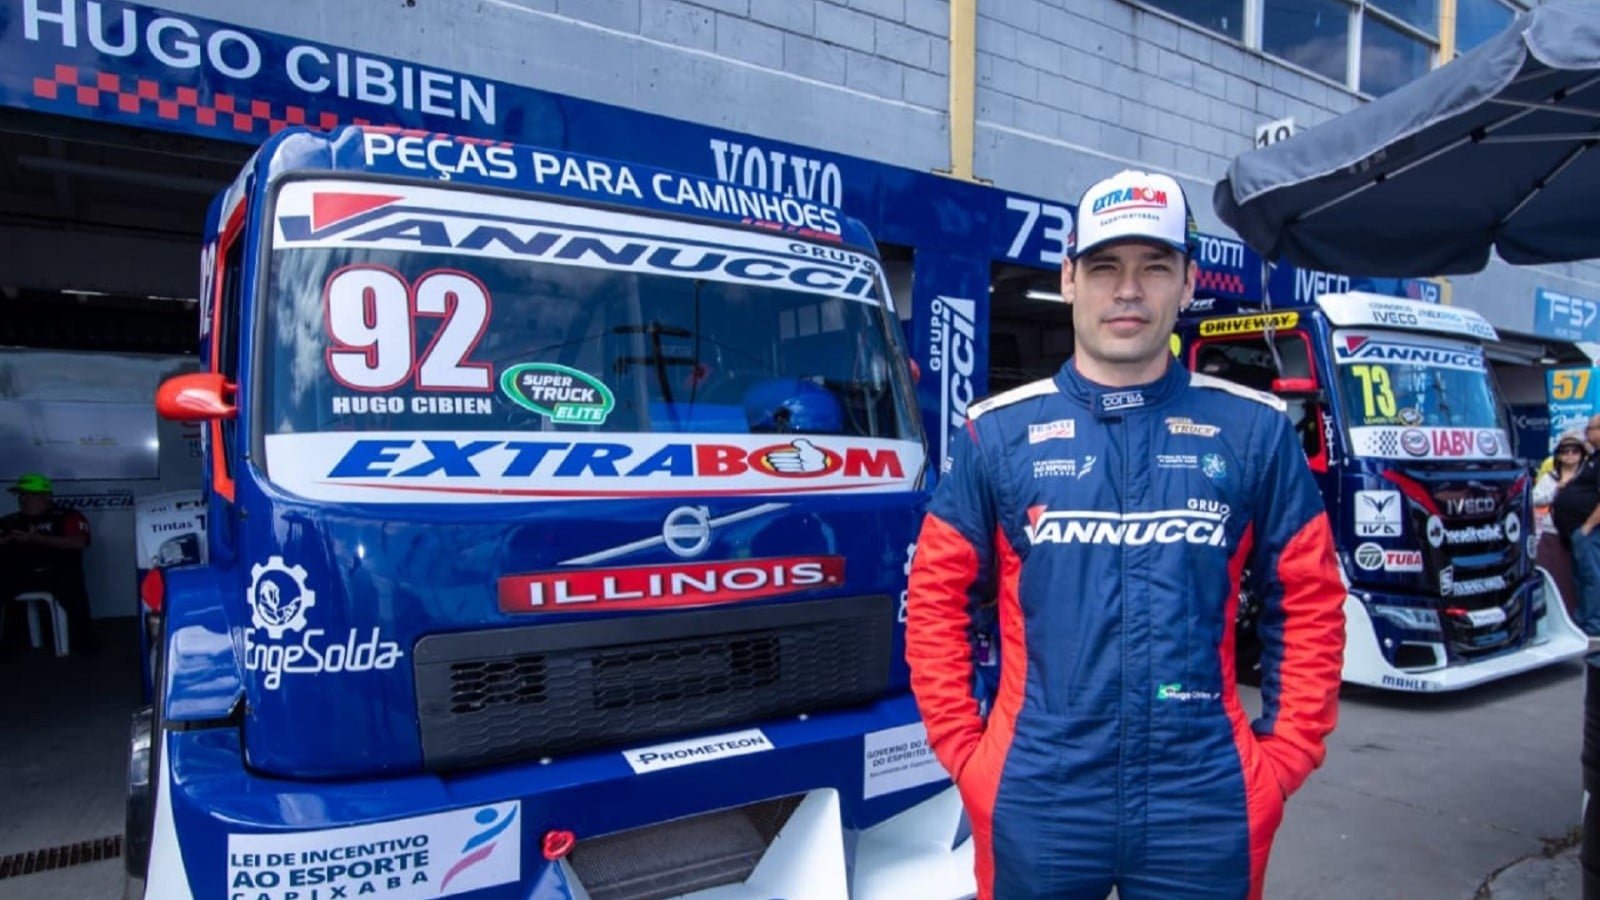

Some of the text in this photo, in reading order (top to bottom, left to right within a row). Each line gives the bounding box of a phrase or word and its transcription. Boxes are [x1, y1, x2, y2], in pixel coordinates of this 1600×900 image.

[23, 0, 497, 126] HUGO CIBIEN
[363, 132, 519, 182] PEÇAS
[532, 151, 644, 200] PARA
[709, 138, 842, 209] VOLVO
[1092, 187, 1168, 214] EXTRABOM
[278, 192, 881, 303] VANNUCCI
[1005, 196, 1073, 264] 73
[1199, 237, 1245, 268] TOTTI
[1294, 267, 1350, 303] IVECO
[324, 263, 494, 392] 92
[1205, 314, 1291, 334] DRIVEWAY
[1372, 310, 1419, 326] IVECO
[522, 373, 573, 388] SUPER
[530, 385, 596, 403] TRUCK
[1351, 364, 1398, 418] 73
[1552, 368, 1591, 400] 57
[331, 396, 493, 416] HUGO CIBIEN
[555, 406, 604, 422] ELITE
[326, 438, 905, 479] EXTRABOM
[1446, 498, 1495, 515] IVECO
[1024, 505, 1227, 547] VANNUCCI
[231, 834, 430, 868] LEI DE INCENTIVO
[232, 850, 430, 888] AO ESPORTE
